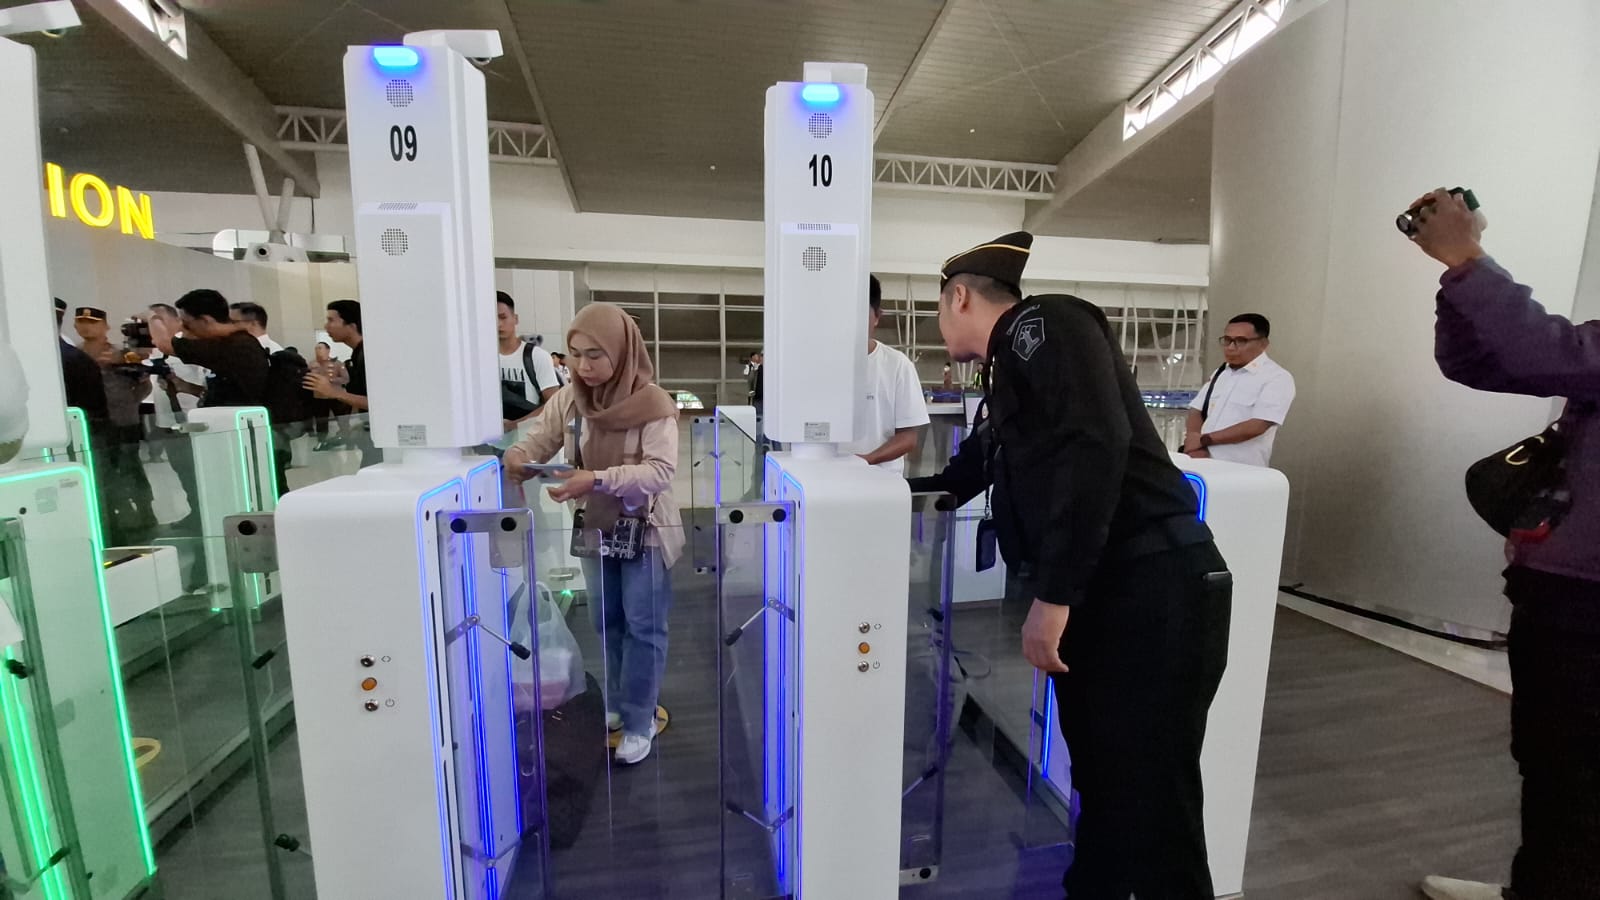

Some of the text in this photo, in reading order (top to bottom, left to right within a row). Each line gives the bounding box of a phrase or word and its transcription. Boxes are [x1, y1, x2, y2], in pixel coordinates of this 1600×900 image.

[390, 125, 417, 161] 09
[809, 154, 832, 187] 10
[45, 162, 155, 240] ION
